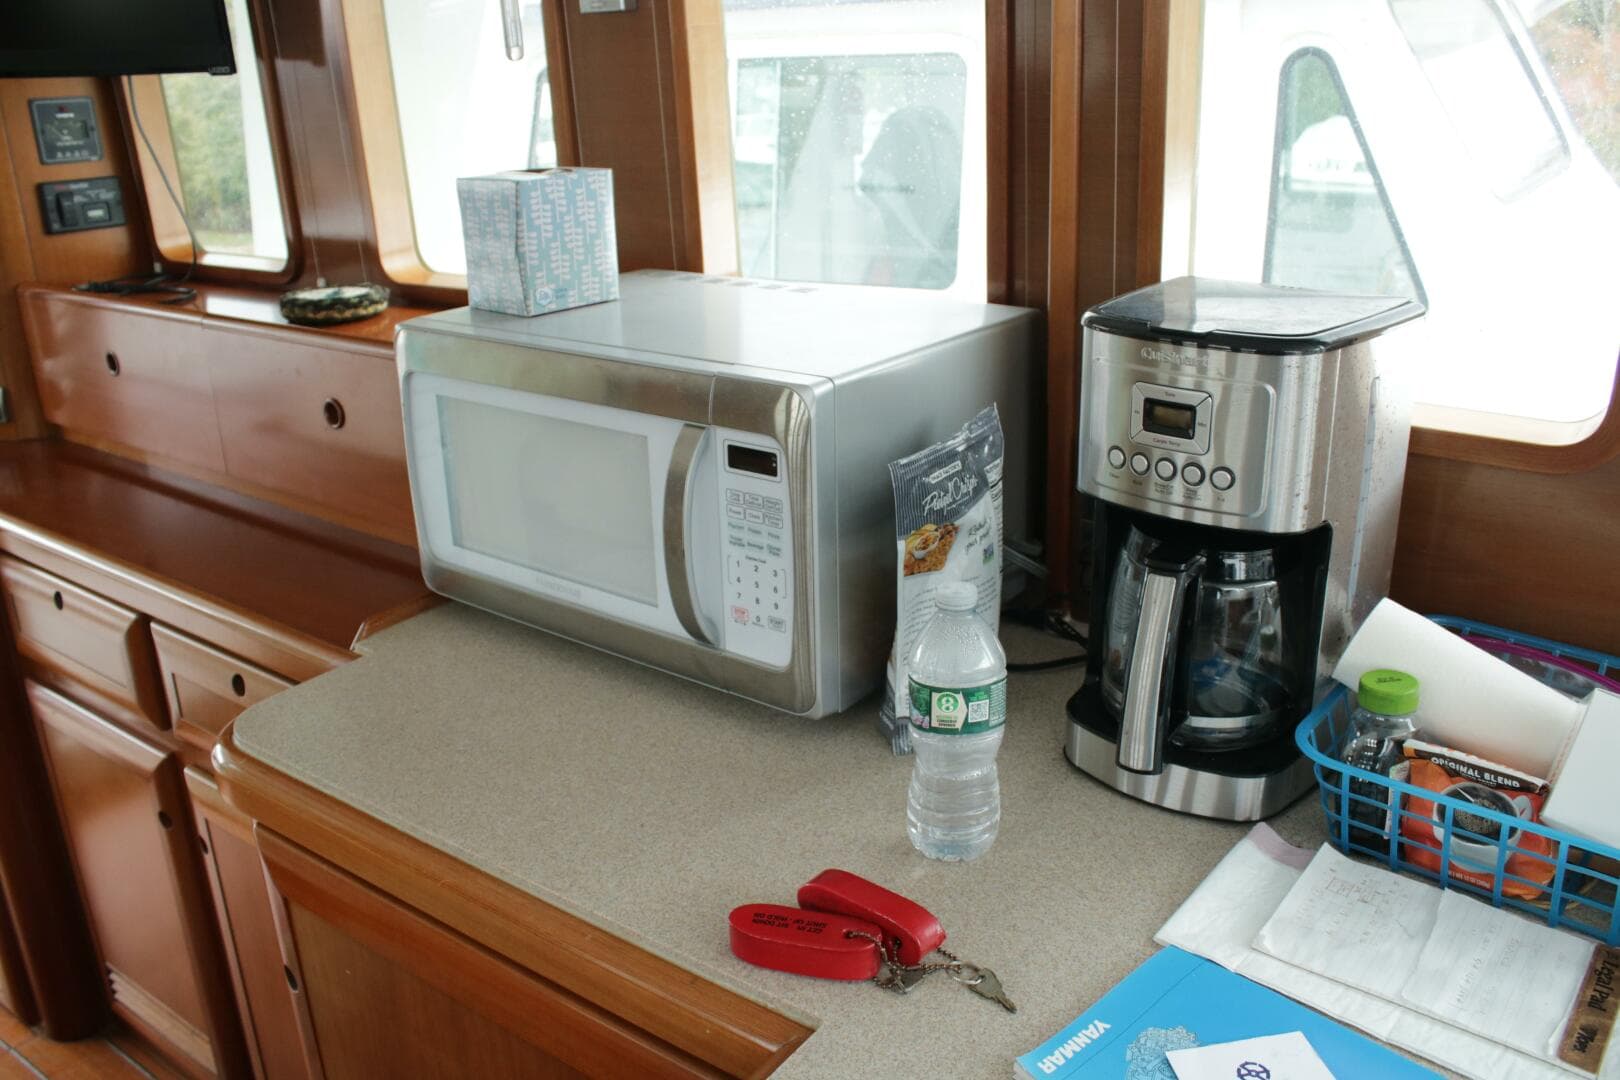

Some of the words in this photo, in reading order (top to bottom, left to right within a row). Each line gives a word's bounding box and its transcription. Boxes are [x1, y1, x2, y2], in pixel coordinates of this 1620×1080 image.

[1483, 772, 1520, 788] BLEND
[1594, 961, 1619, 991] Legal
[1588, 988, 1611, 1012] Pad
[1037, 1019, 1112, 1074] YANMAR
